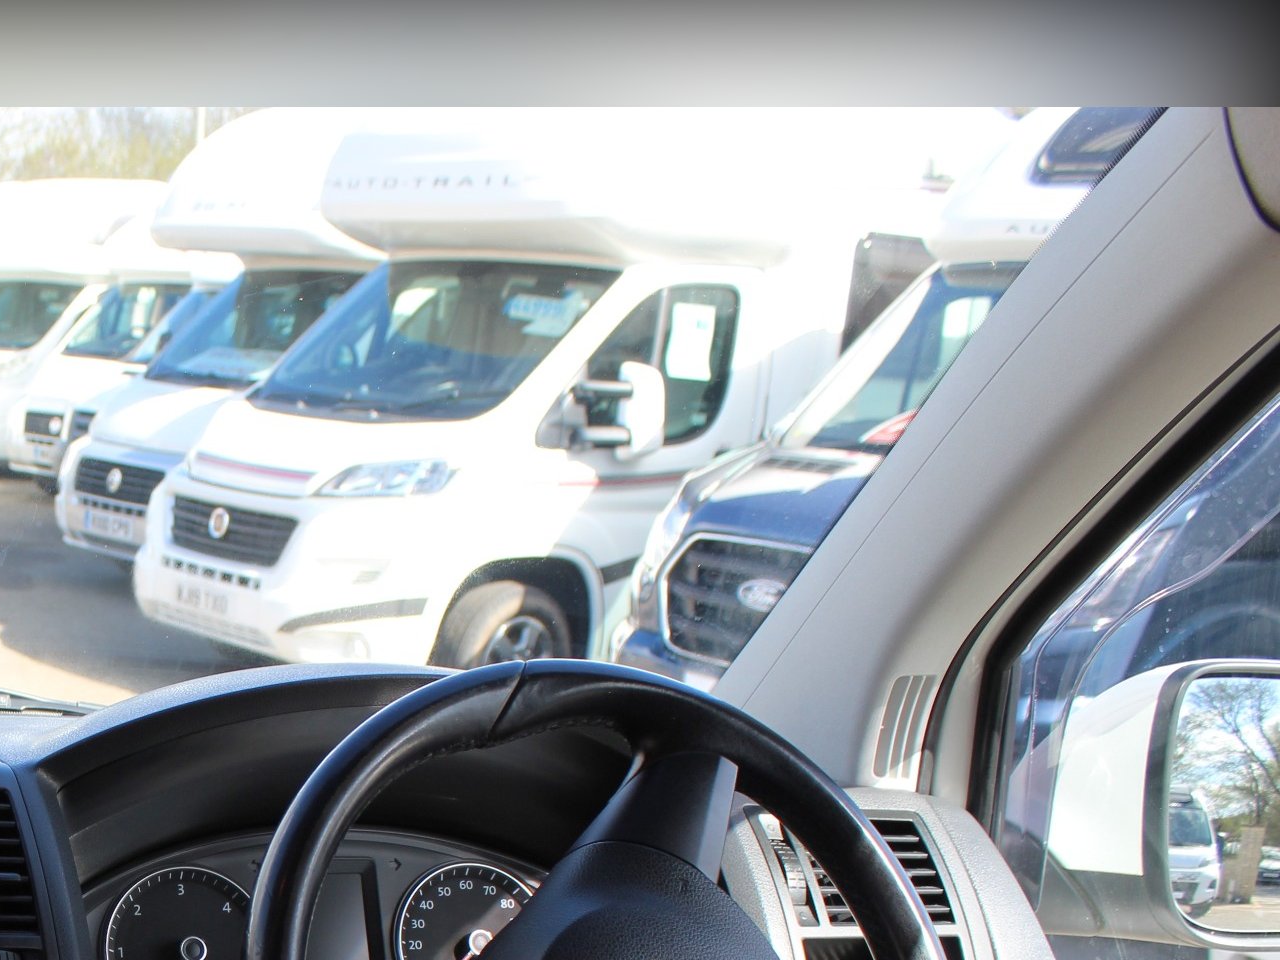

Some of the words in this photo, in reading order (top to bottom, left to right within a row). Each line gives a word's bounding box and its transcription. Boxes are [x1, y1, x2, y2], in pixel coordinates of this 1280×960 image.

[177, 884, 185, 896] 3
[459, 880, 473, 890] 60
[438, 887, 451, 897] 50
[483, 886, 496, 895] 70
[222, 902, 232, 914] 4
[419, 900, 434, 910] 40
[500, 899, 515, 909] 80
[133, 904, 142, 916] 2
[411, 919, 425, 929] 30
[409, 940, 423, 950] 20
[118, 947, 123, 958] 1
